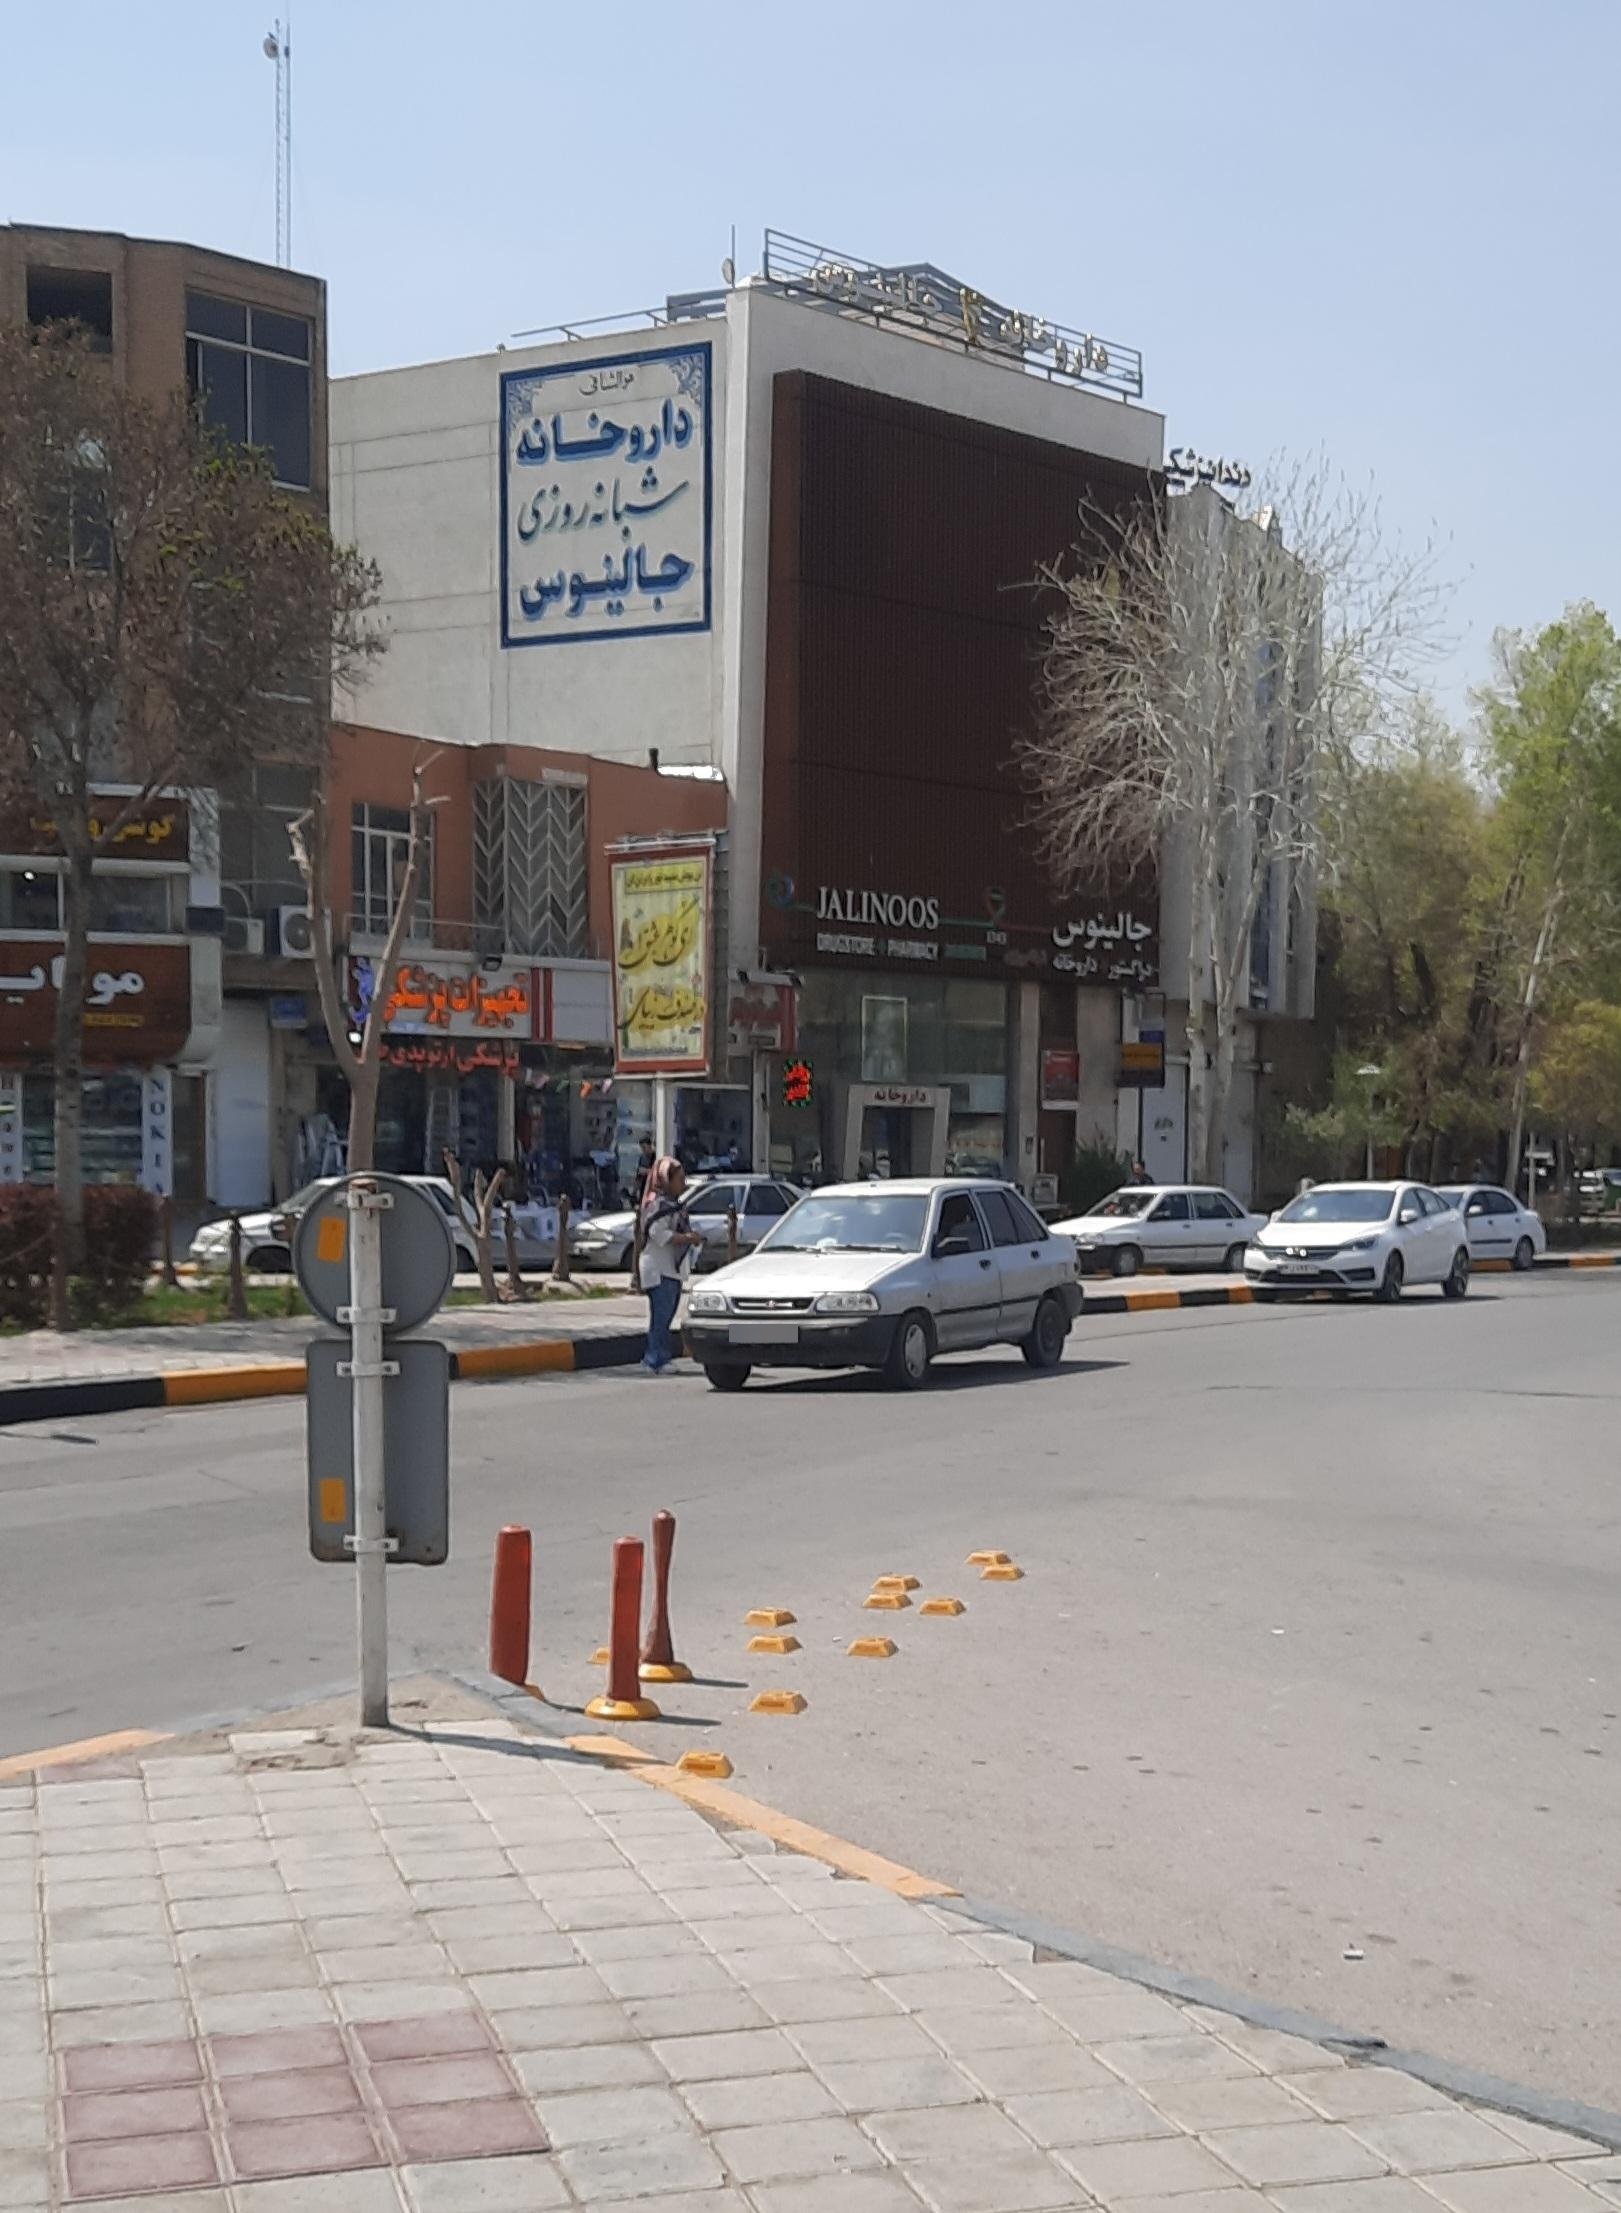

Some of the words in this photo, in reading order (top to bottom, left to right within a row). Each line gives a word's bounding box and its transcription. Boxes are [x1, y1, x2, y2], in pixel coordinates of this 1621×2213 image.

[515, 397, 694, 466] داروخانه
[517, 484, 591, 545] روزی
[590, 465, 689, 541] شبانه
[518, 543, 694, 622] جالینوس
[816, 886, 939, 930] JALINOOS
[1052, 911, 1152, 952] جالینوس
[873, 1088, 927, 1104] داروخانه
